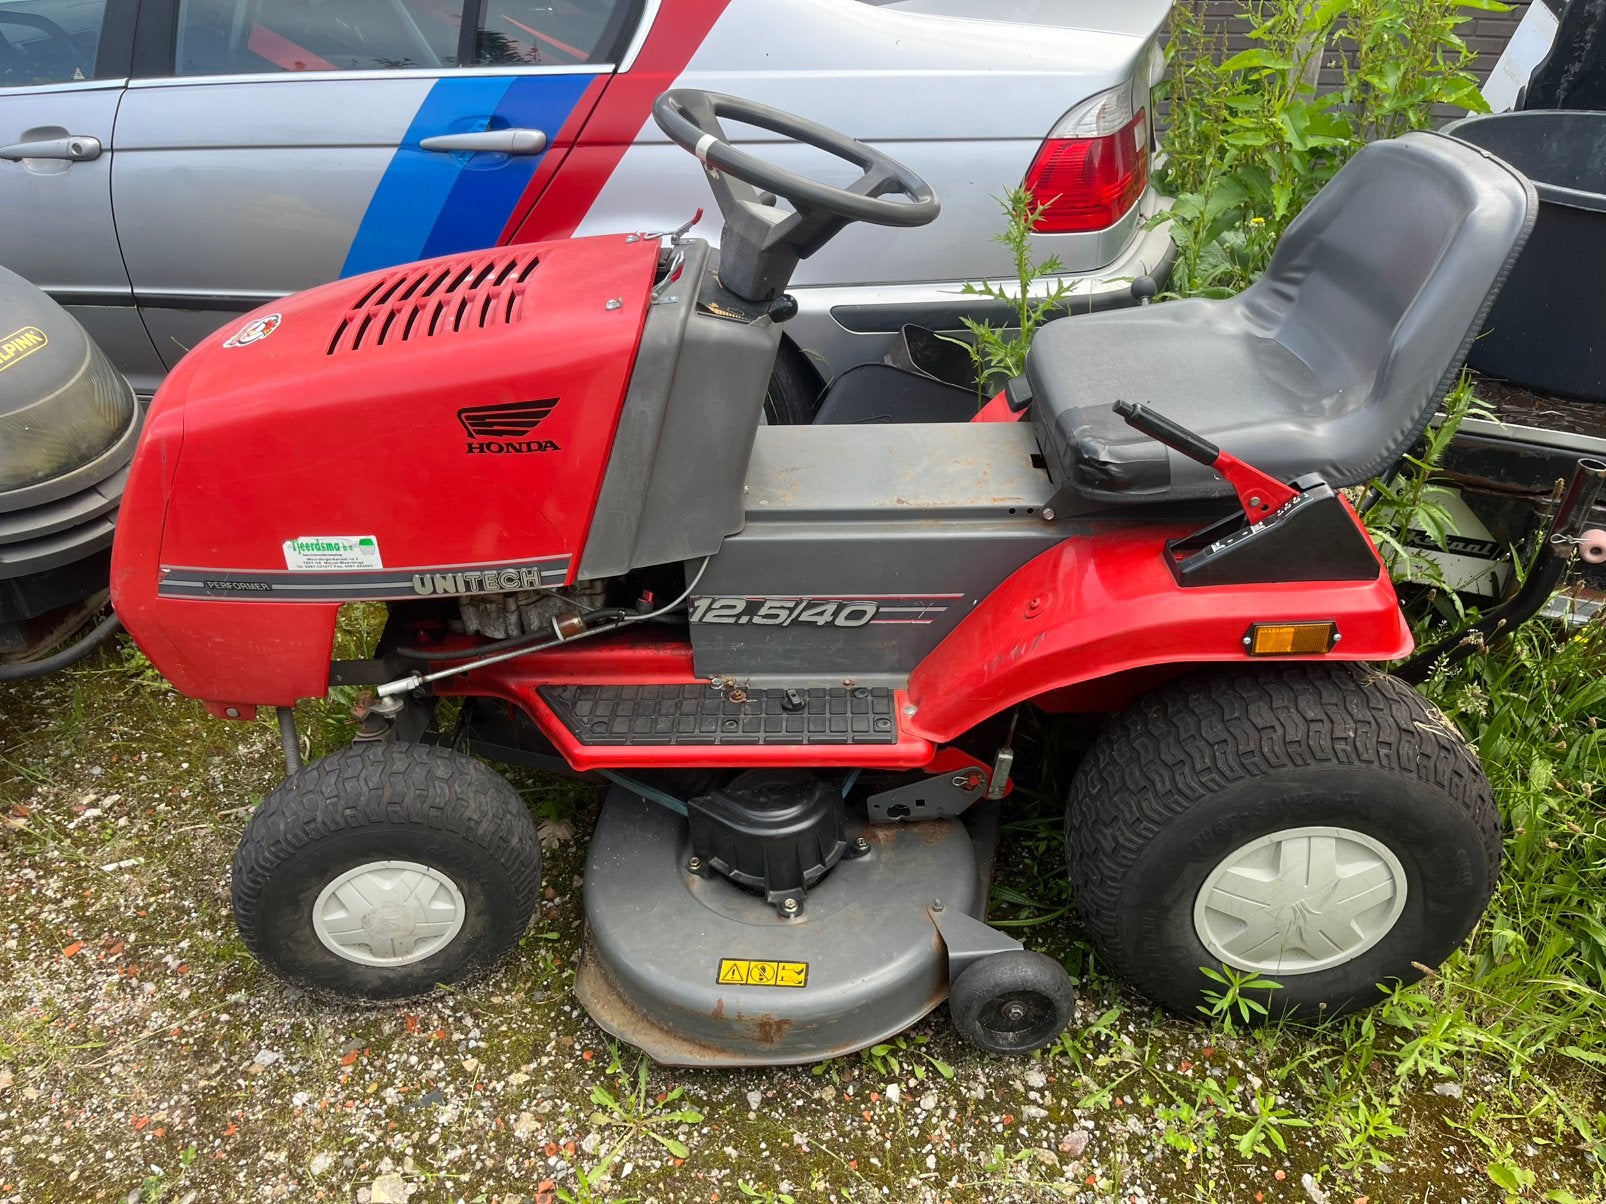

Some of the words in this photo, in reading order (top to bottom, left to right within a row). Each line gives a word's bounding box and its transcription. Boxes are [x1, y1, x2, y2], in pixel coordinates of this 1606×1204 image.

[465, 440, 561, 454] HONDA
[291, 539, 340, 554] Tjeerdsma
[206, 581, 271, 591] PERFORMER
[412, 566, 541, 595] UNITECH
[689, 597, 880, 627] 12.5/40
